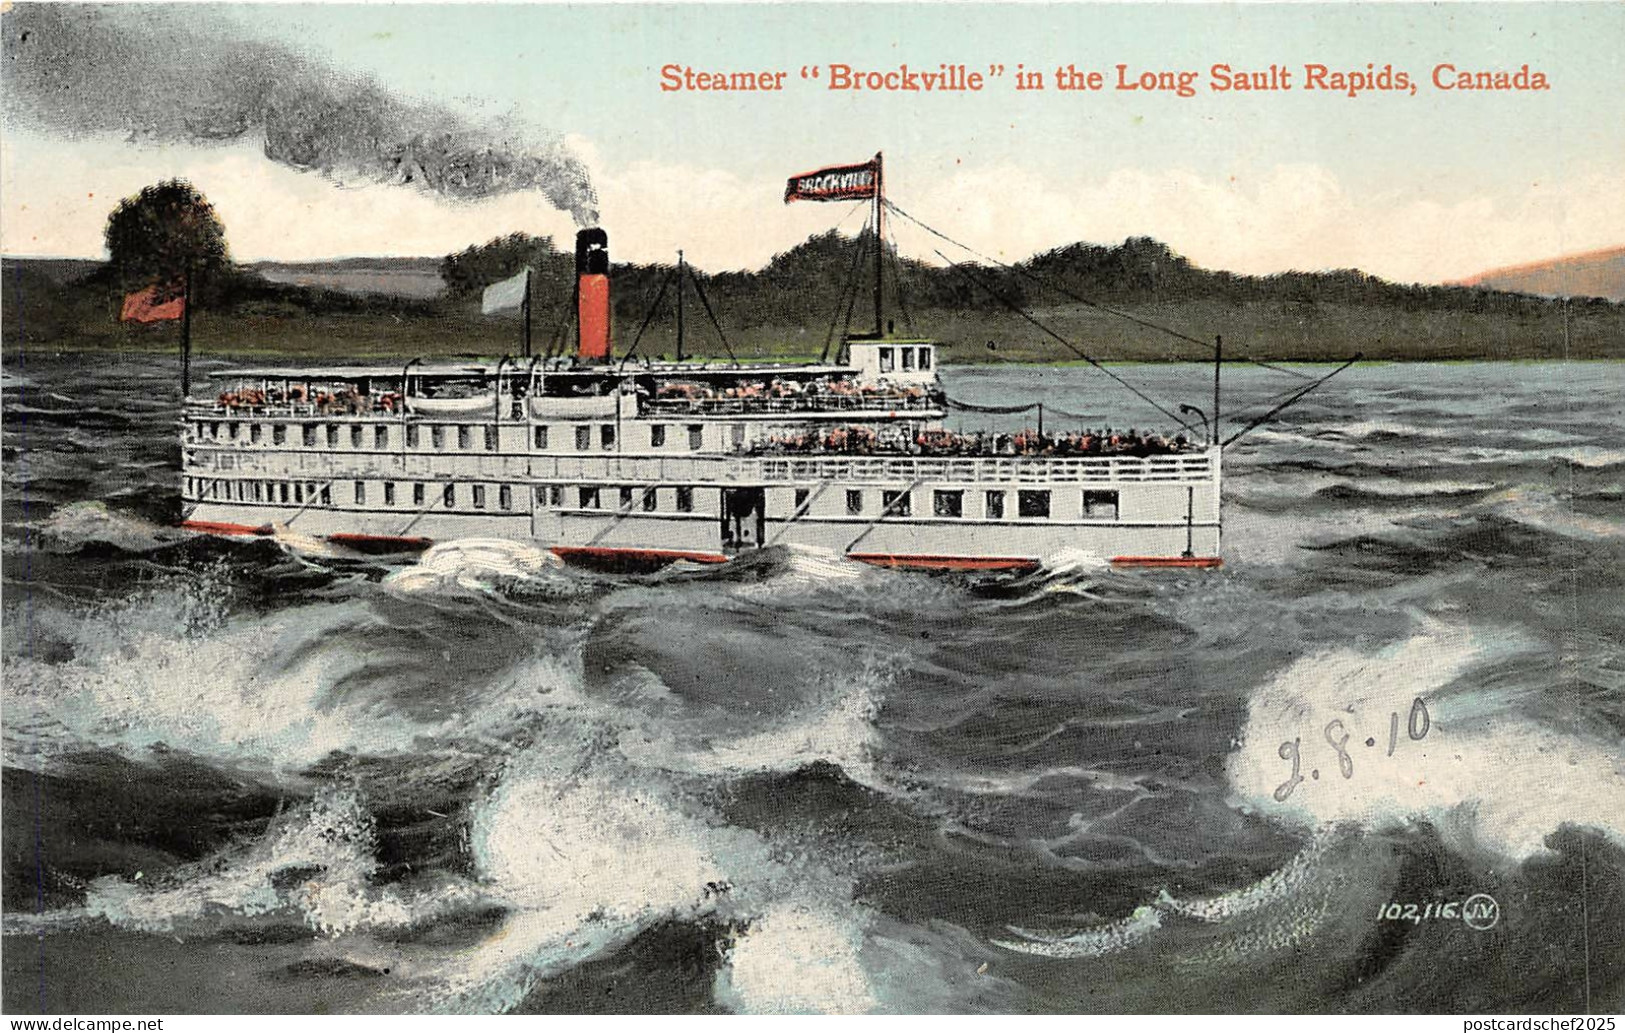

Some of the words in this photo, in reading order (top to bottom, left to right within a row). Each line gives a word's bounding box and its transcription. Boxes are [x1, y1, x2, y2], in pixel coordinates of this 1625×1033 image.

[660, 64, 787, 91] Steamer
[1015, 64, 1044, 91] in
[1056, 64, 1102, 91] the
[1116, 64, 1199, 98] Long
[1210, 64, 1291, 91] Sault
[1304, 63, 1417, 98] Rapids,
